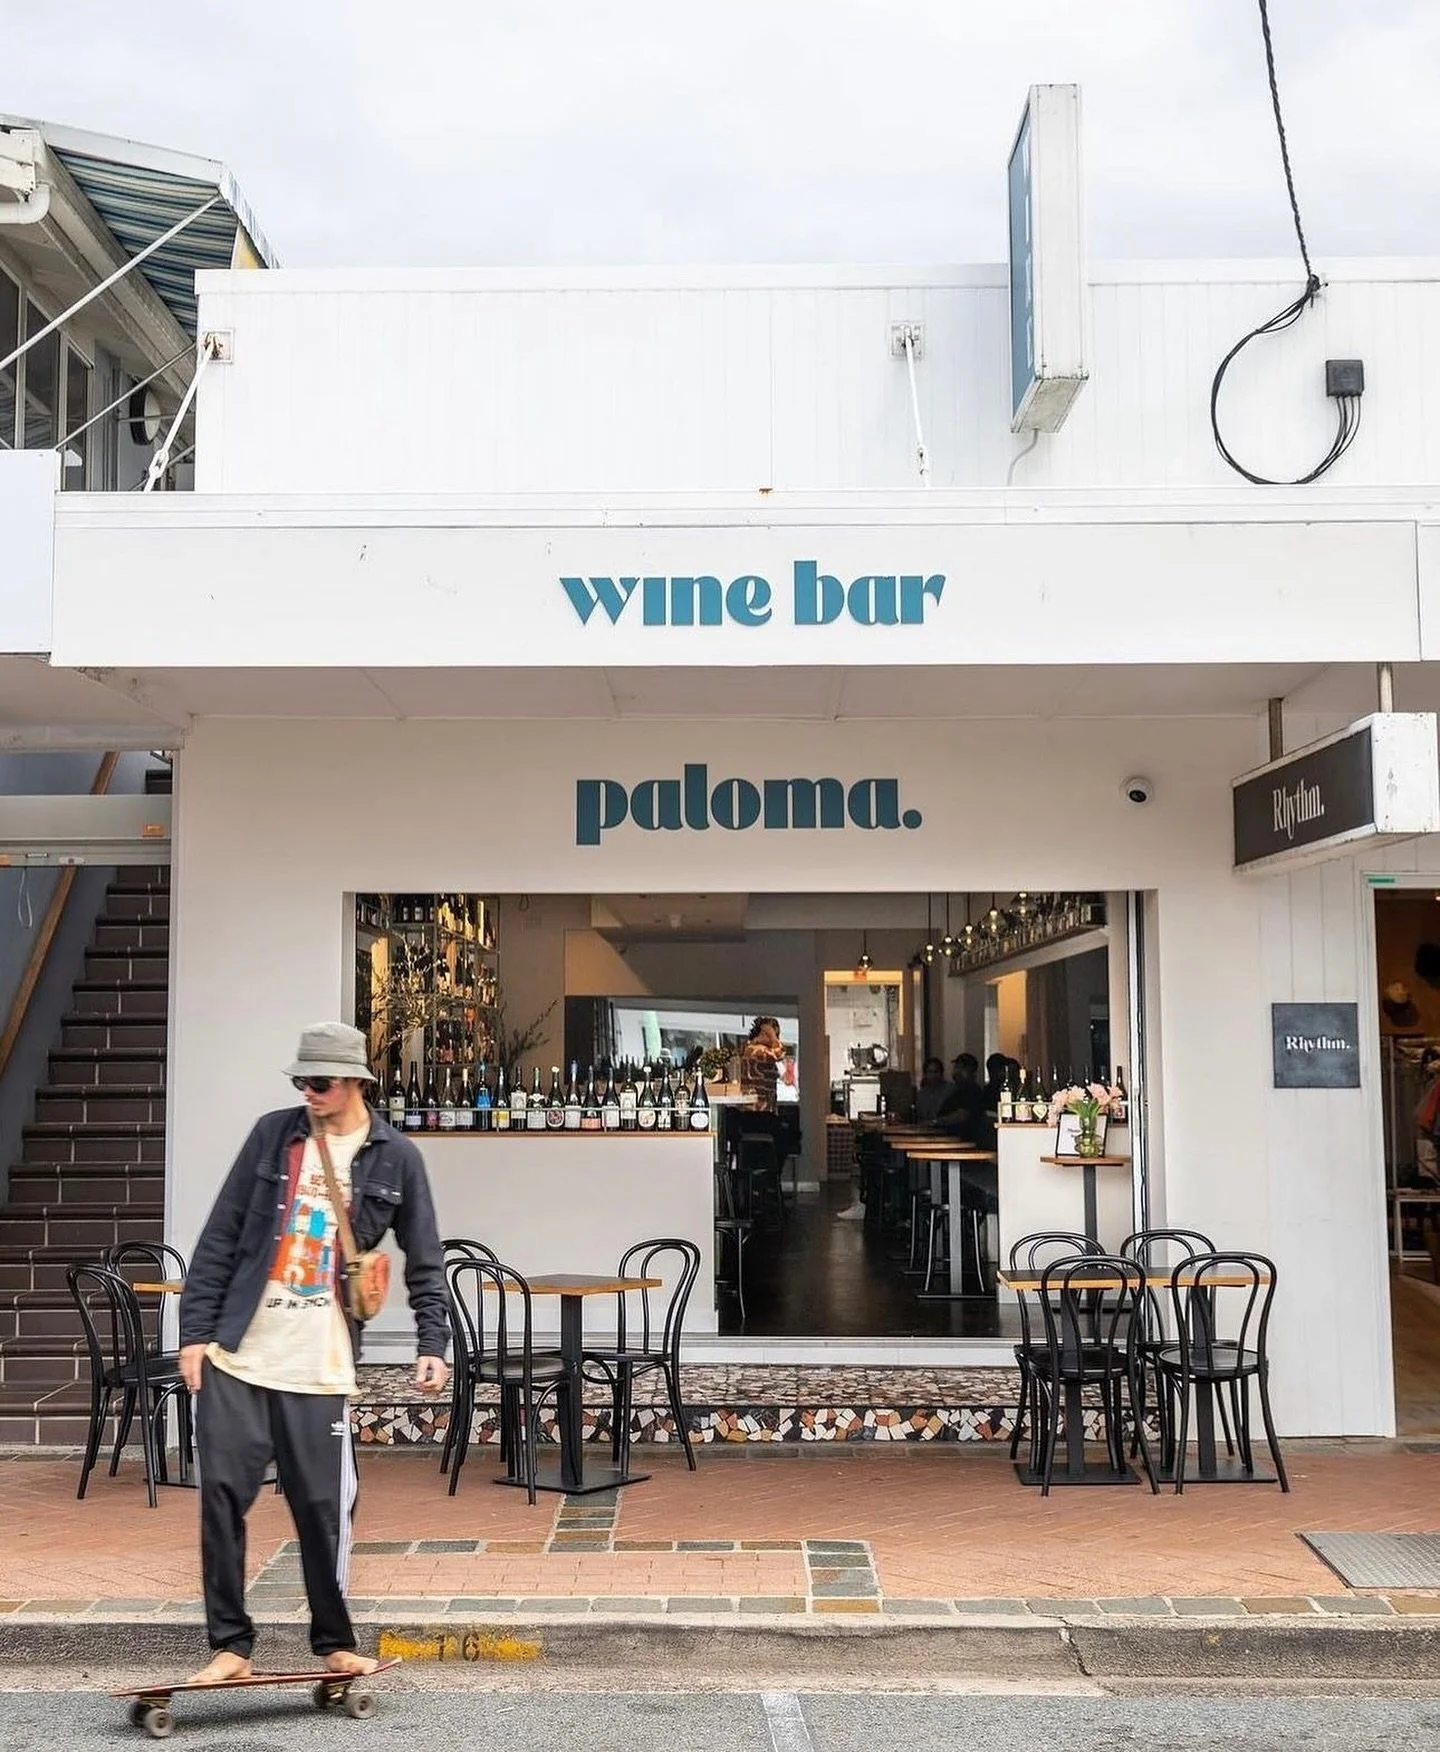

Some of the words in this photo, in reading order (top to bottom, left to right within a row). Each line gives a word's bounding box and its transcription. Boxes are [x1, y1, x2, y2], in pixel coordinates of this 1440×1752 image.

[558, 576, 773, 627] wine
[794, 559, 947, 626] bar
[576, 763, 923, 846] paloma.
[1272, 777, 1325, 840] Rhythm.
[1285, 1035, 1351, 1053] Rhythm.
